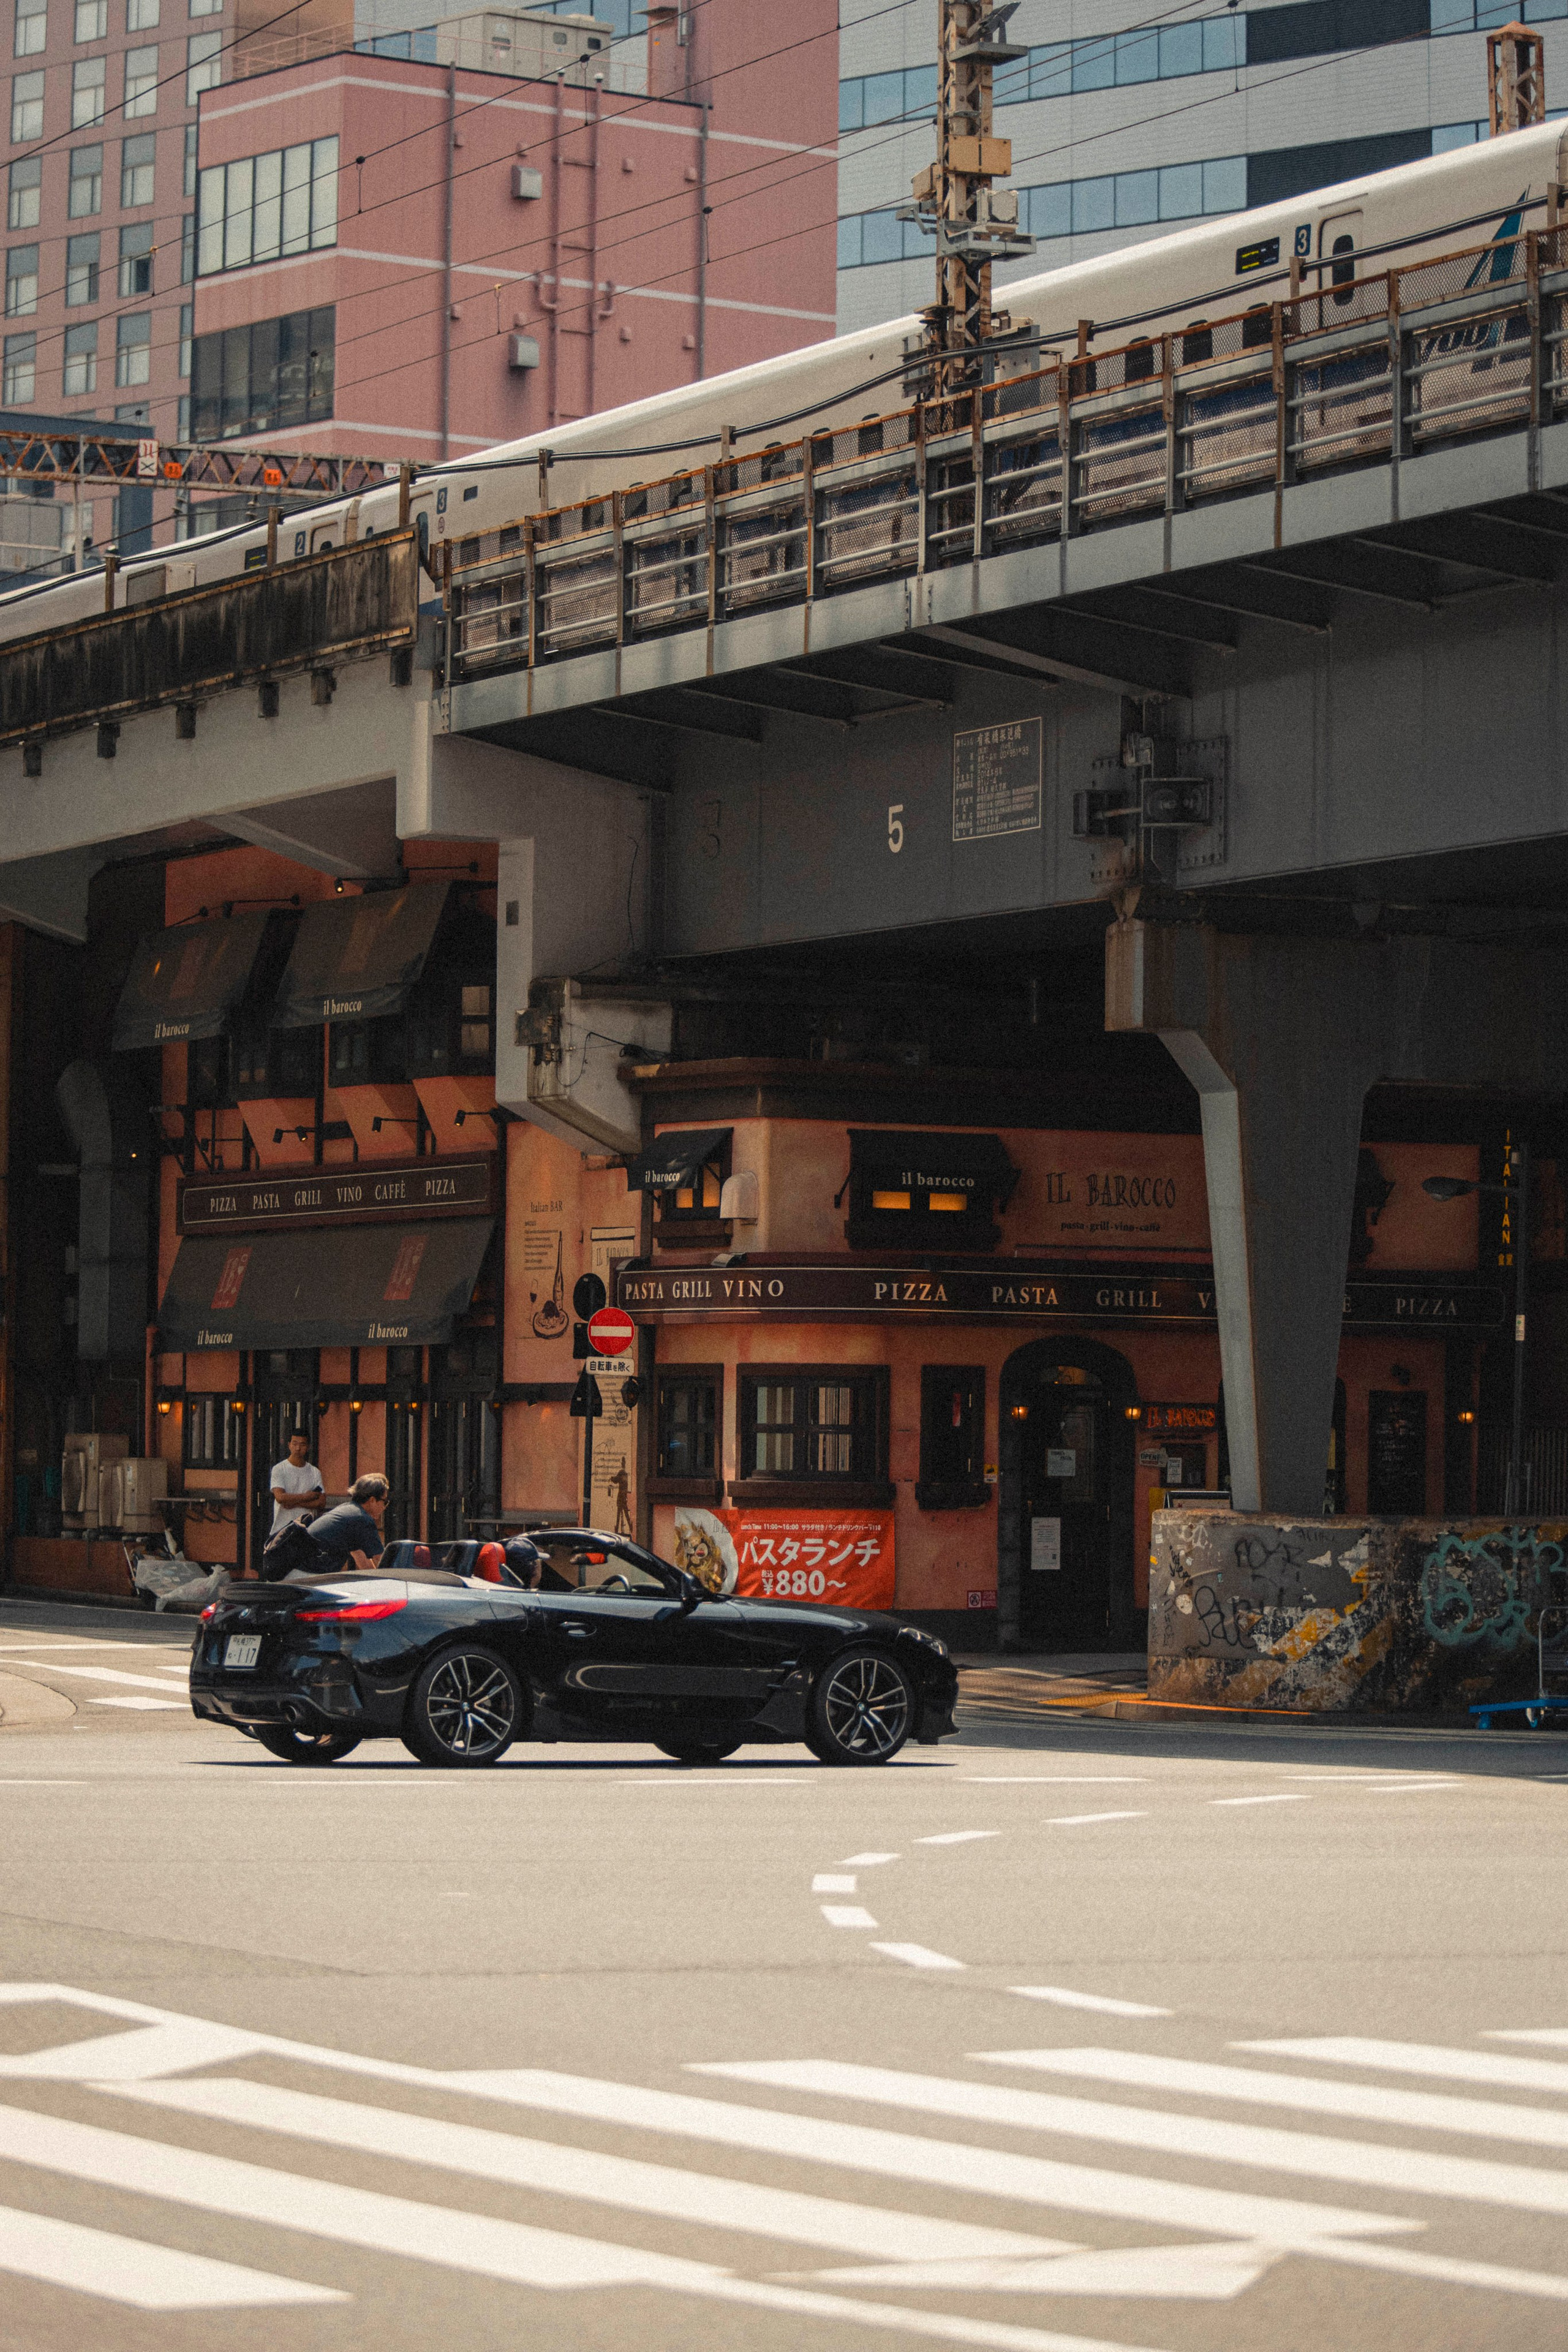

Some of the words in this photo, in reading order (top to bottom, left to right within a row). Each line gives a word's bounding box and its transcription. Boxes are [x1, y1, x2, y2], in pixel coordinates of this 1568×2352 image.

[1297, 229, 1307, 254] 3
[439, 492, 445, 510] 3
[296, 534, 304, 554] 2
[888, 804, 903, 853] 5
[323, 1000, 330, 1015] il
[331, 999, 361, 1014] barocco
[154, 1024, 161, 1038] il
[162, 1023, 189, 1038] barocco
[645, 1170, 651, 1183] il
[652, 1170, 680, 1183] barocco
[902, 1172, 912, 1185] il
[917, 1173, 975, 1186] barocco
[210, 1197, 236, 1213] PIZZA
[253, 1193, 281, 1210] PASTA
[295, 1189, 322, 1206] GRILL
[336, 1186, 362, 1203] VINO
[374, 1180, 406, 1200] CAFFÈ
[426, 1179, 456, 1196] PIZZA
[1046, 1172, 1071, 1204] IL
[1086, 1174, 1176, 1209] BAROCCO
[530, 1201, 549, 1213] Italian
[550, 1200, 564, 1212] BAR
[1060, 1221, 1085, 1231] pasta
[1090, 1221, 1110, 1232] grill
[1114, 1221, 1134, 1231] vino
[625, 1282, 663, 1300] PASTA
[673, 1281, 712, 1298] GRILL
[723, 1280, 784, 1297] VINO
[874, 1283, 948, 1302] PIZZA
[992, 1286, 1059, 1305] PASTA
[1096, 1289, 1162, 1308] GRILL
[1396, 1297, 1458, 1316] PIZZA
[197, 1331, 204, 1345] il
[205, 1330, 233, 1344] barocco
[368, 1324, 375, 1338] il
[376, 1323, 408, 1338] barocco
[590, 1361, 630, 1372] 自転車を除く
[741, 1536, 881, 1567] パスタランチ
